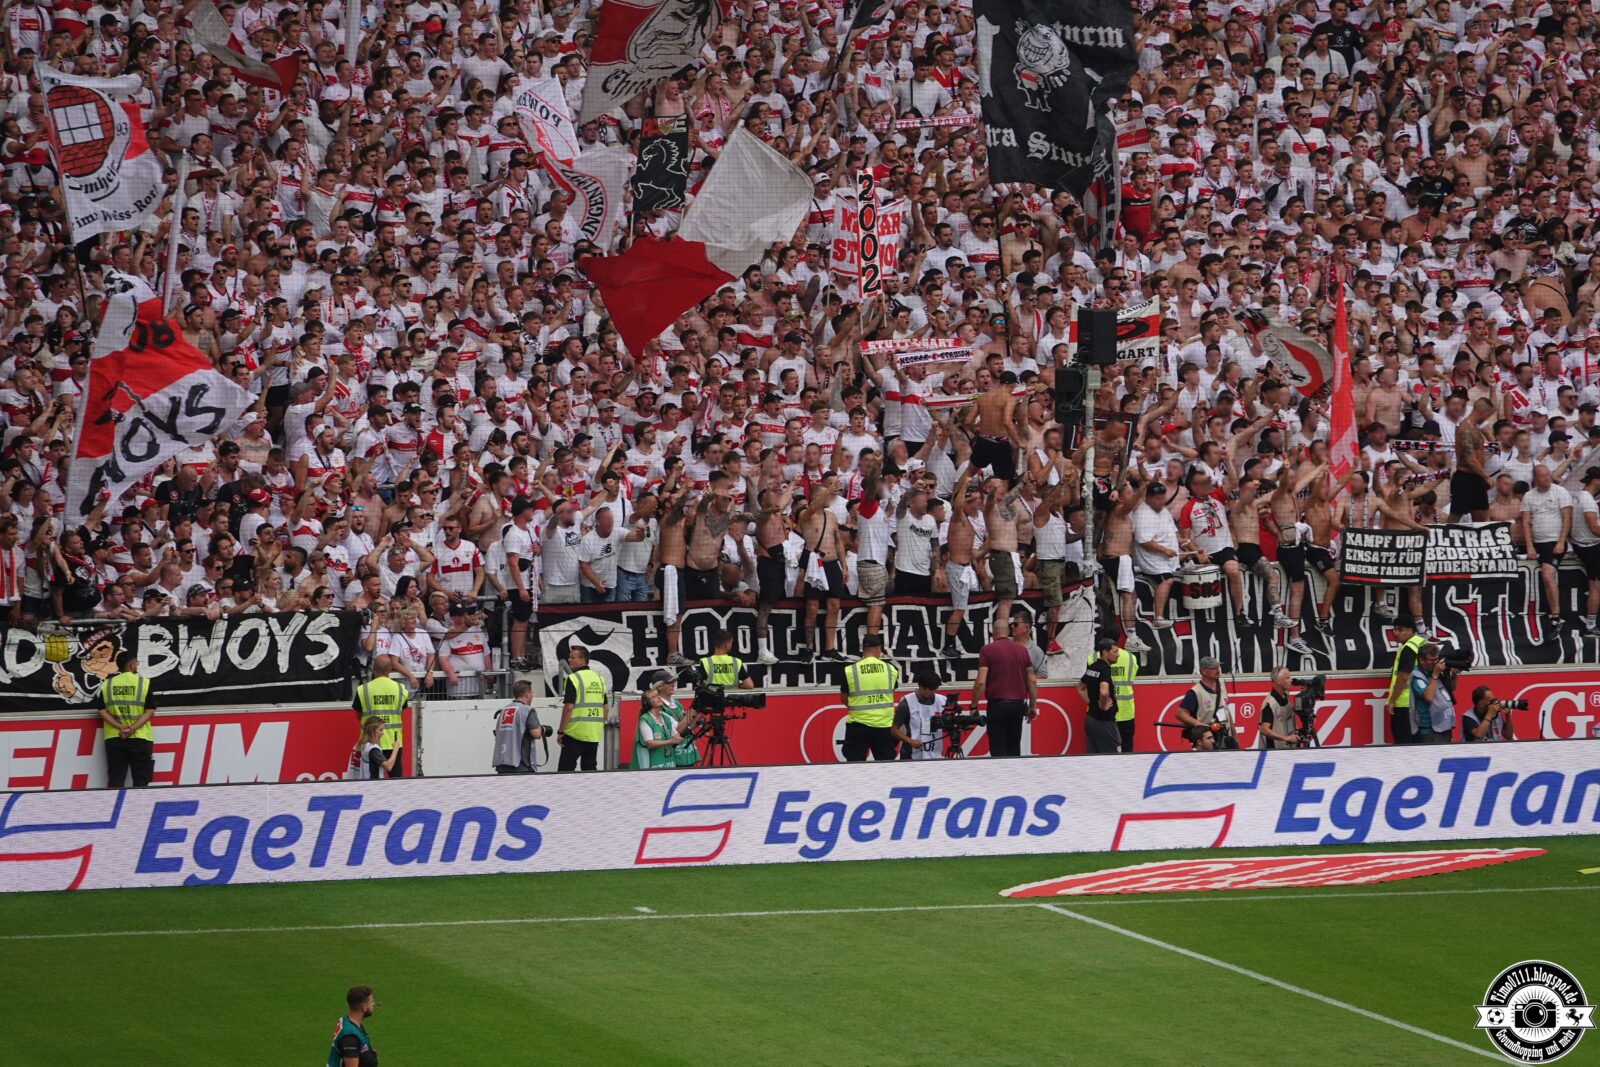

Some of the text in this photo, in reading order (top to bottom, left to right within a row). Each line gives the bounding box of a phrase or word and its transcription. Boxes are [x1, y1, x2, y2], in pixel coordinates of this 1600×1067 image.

[858, 173, 881, 293] 2002
[1345, 532, 1424, 549] KAMPF UND
[1345, 548, 1422, 563] EINSATZ FÜR
[1426, 545, 1514, 561] BEDEUTET
[1345, 565, 1421, 576] UNSERE FARBEN!
[1426, 559, 1517, 574] WIDERSTAND
[137, 612, 341, 679] BWOYS
[713, 664, 735, 676] SECURITY
[860, 663, 885, 675] SECURITY
[113, 686, 136, 696] SECURITY
[373, 695, 396, 705] SECURITY
[765, 786, 1064, 859] EgeTrans
[135, 794, 550, 886] EgeTrans
